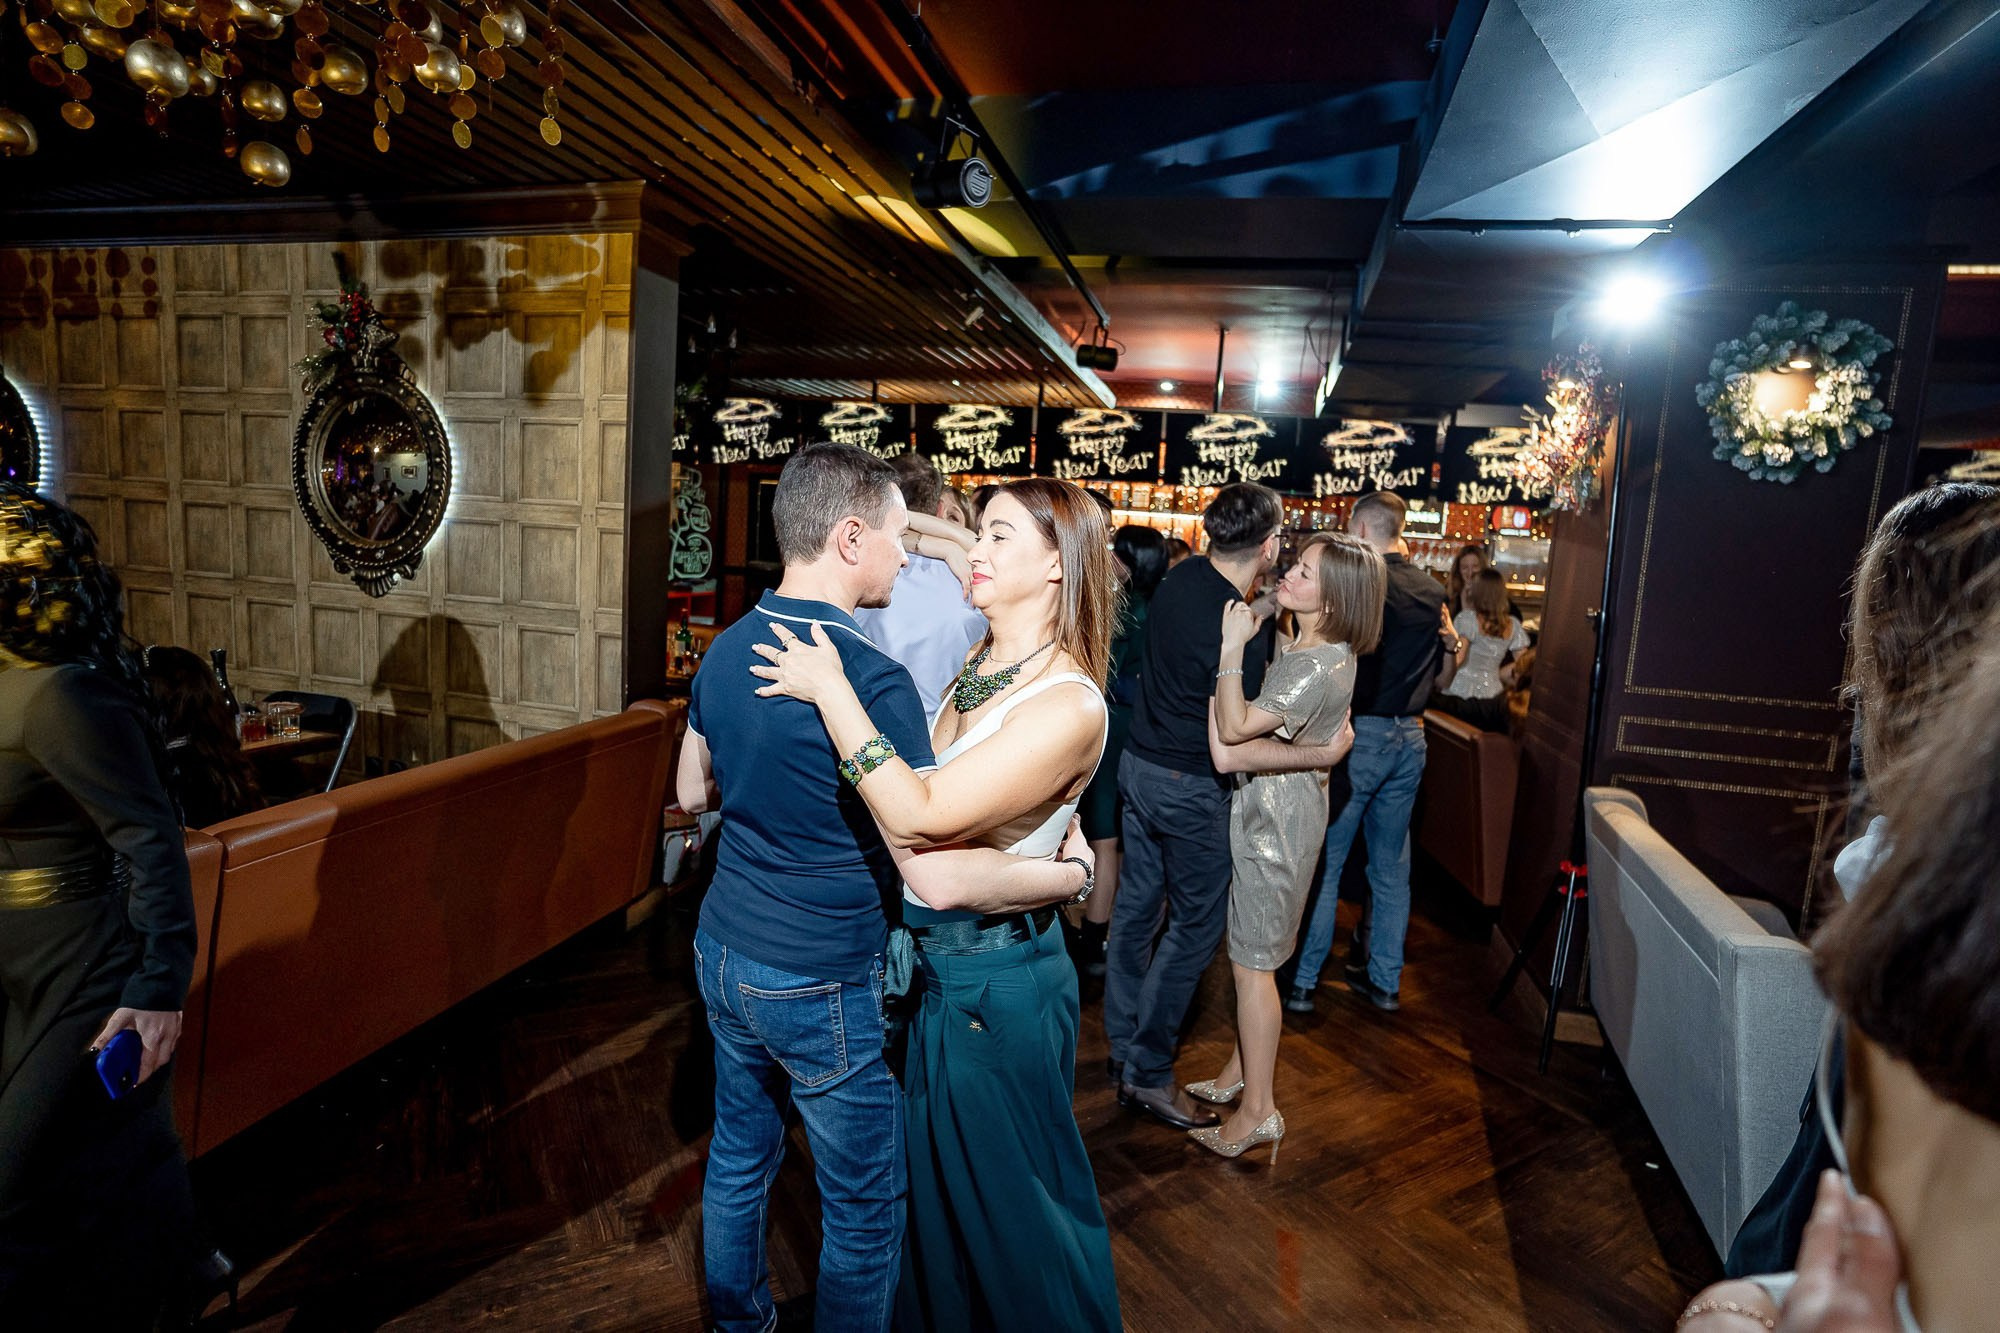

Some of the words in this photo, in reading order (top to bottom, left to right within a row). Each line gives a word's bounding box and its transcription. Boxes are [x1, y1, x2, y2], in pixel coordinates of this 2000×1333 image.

[672, 434, 689, 450] ar
[723, 423, 769, 444] Happy
[945, 430, 998, 453] Happy
[712, 445, 751, 464] New
[752, 437, 794, 459] Year
[1070, 436, 1125, 459] Happy
[1199, 441, 1258, 466] Happy
[931, 453, 975, 474] New
[978, 446, 1026, 469] Year
[1053, 459, 1100, 479] New
[1103, 451, 1154, 475] Year
[1334, 449, 1395, 473] Happy
[1181, 465, 1231, 487] New
[1234, 459, 1287, 482] Year
[1314, 472, 1365, 498] New
[1369, 467, 1425, 491] Year
[1458, 481, 1512, 504] New
